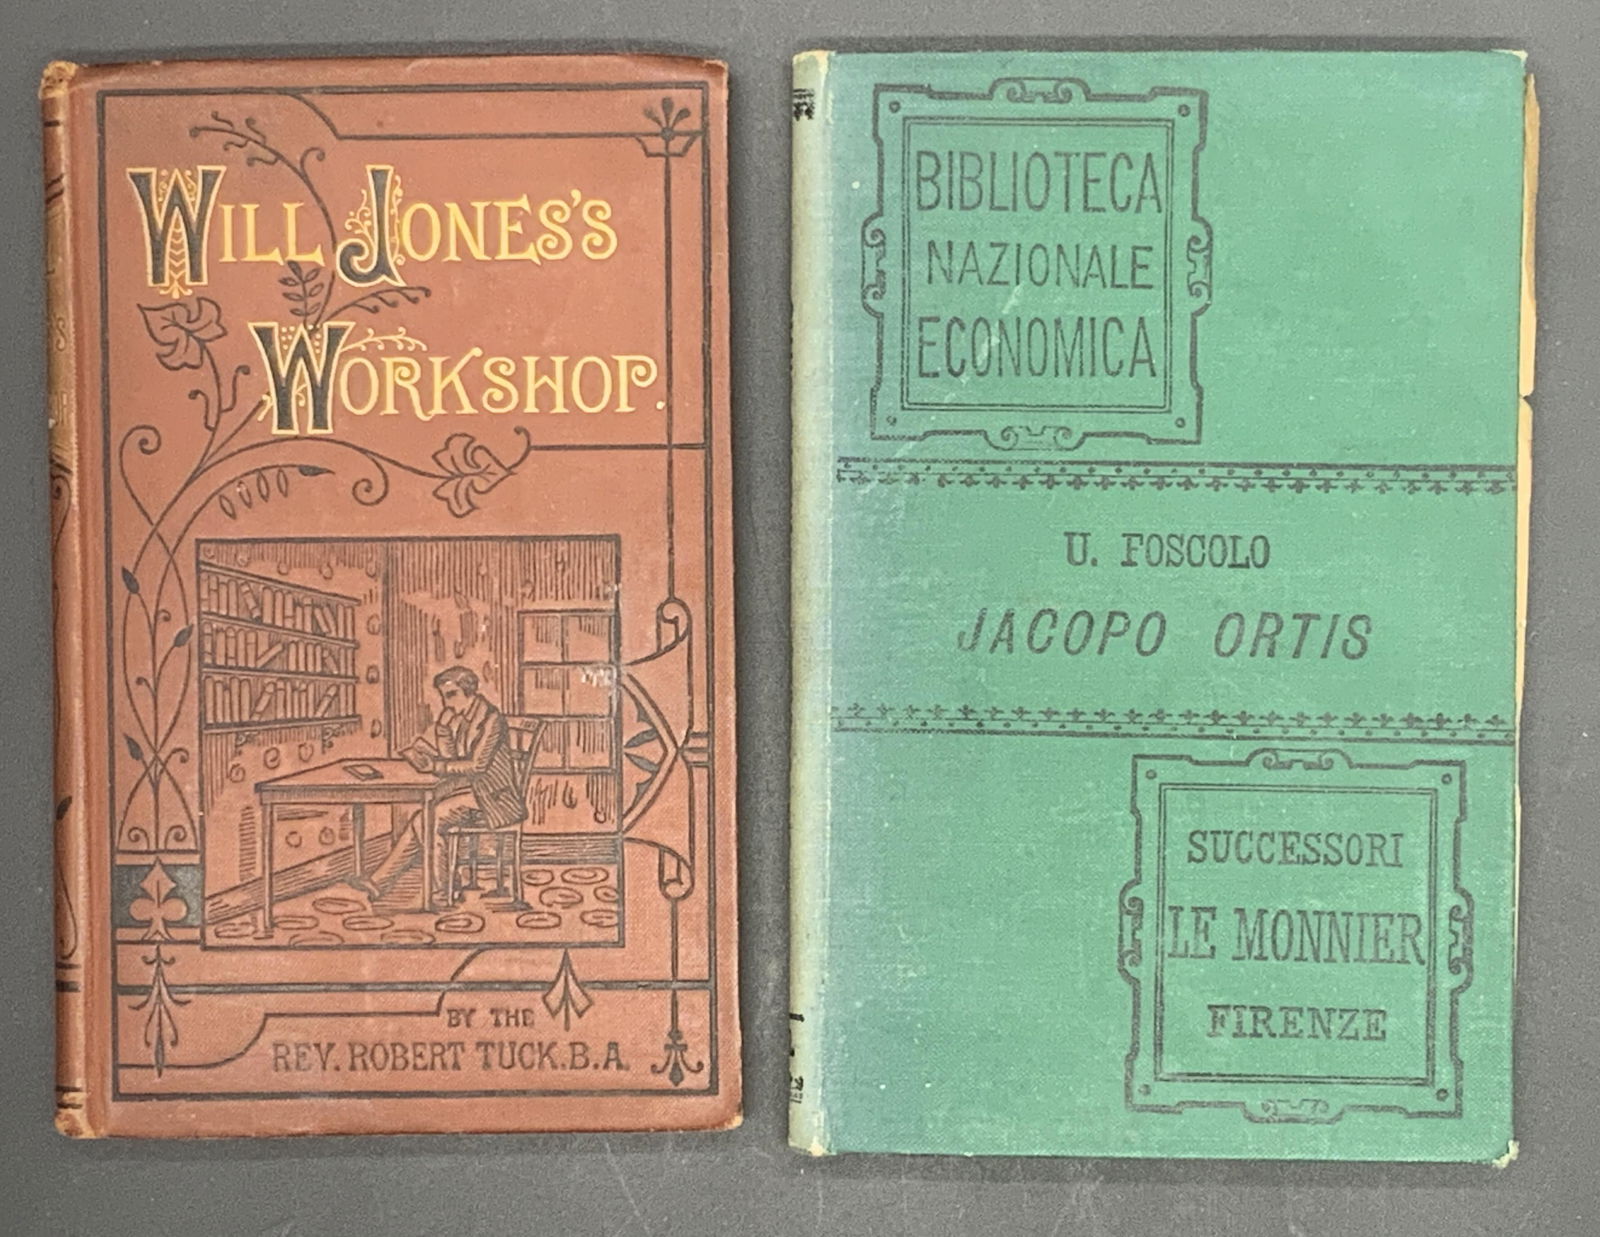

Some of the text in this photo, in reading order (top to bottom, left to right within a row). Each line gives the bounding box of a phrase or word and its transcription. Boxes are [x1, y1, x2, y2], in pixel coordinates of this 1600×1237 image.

[915, 150, 1163, 214] BIBLIOTECA
[126, 165, 325, 293] WILL
[926, 239, 1155, 290] NAZIONALE
[917, 316, 1158, 379] ECONOMICA
[1063, 531, 1272, 570] U. FOSCOLO
[957, 606, 1373, 661] JACOPO ORTIS
[1186, 829, 1405, 869] SUCCESSORI
[1166, 905, 1427, 966] LE MONNIER
[446, 1008, 535, 1028] BY THE
[1206, 1004, 1388, 1042] FIRENZE
[272, 1042, 341, 1073] REV.
[348, 1041, 466, 1072] ROBERT
